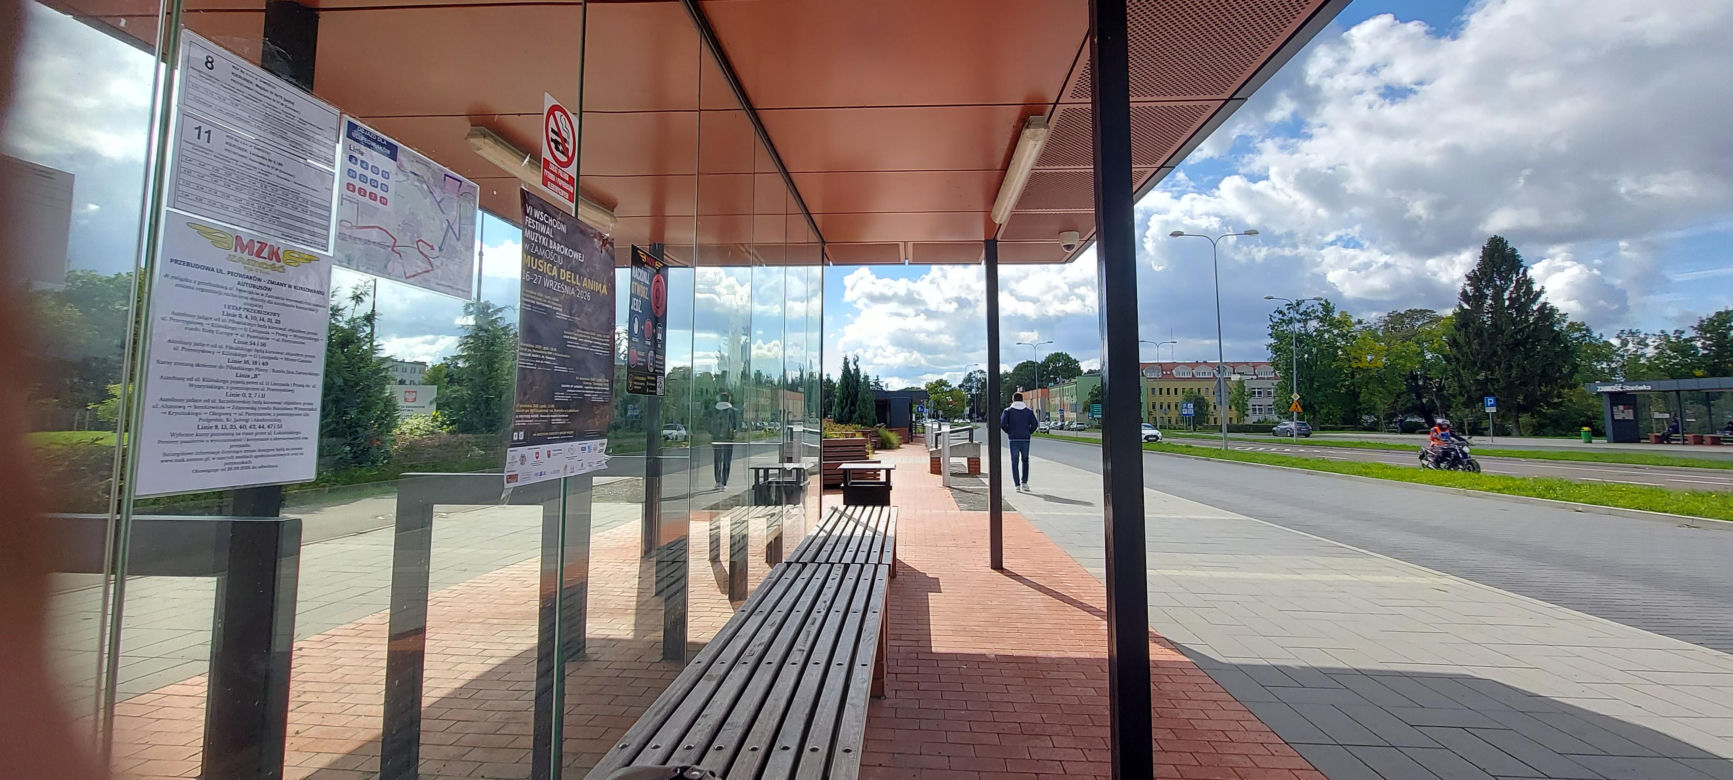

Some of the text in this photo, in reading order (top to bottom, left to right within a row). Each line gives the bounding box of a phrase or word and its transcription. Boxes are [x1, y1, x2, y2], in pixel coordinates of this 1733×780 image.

[204, 55, 215, 70] 8
[194, 126, 211, 144] 11
[526, 204, 567, 233] VI WSCHODNI
[526, 216, 554, 237] FESTIWAL
[234, 236, 282, 263] MZK
[525, 228, 585, 262] MUZYKI BAROKOWEJ
[530, 243, 563, 264] ZAMOŚCIU
[169, 257, 214, 272] PRZEBUDOWA
[266, 279, 287, 288] ZMIANY
[524, 253, 608, 295] MUSICA DELL'ANIMA
[236, 280, 272, 292] AUTOBUSÓW
[543, 276, 576, 296] WRZEŚNIA
[577, 288, 591, 301] 2026
